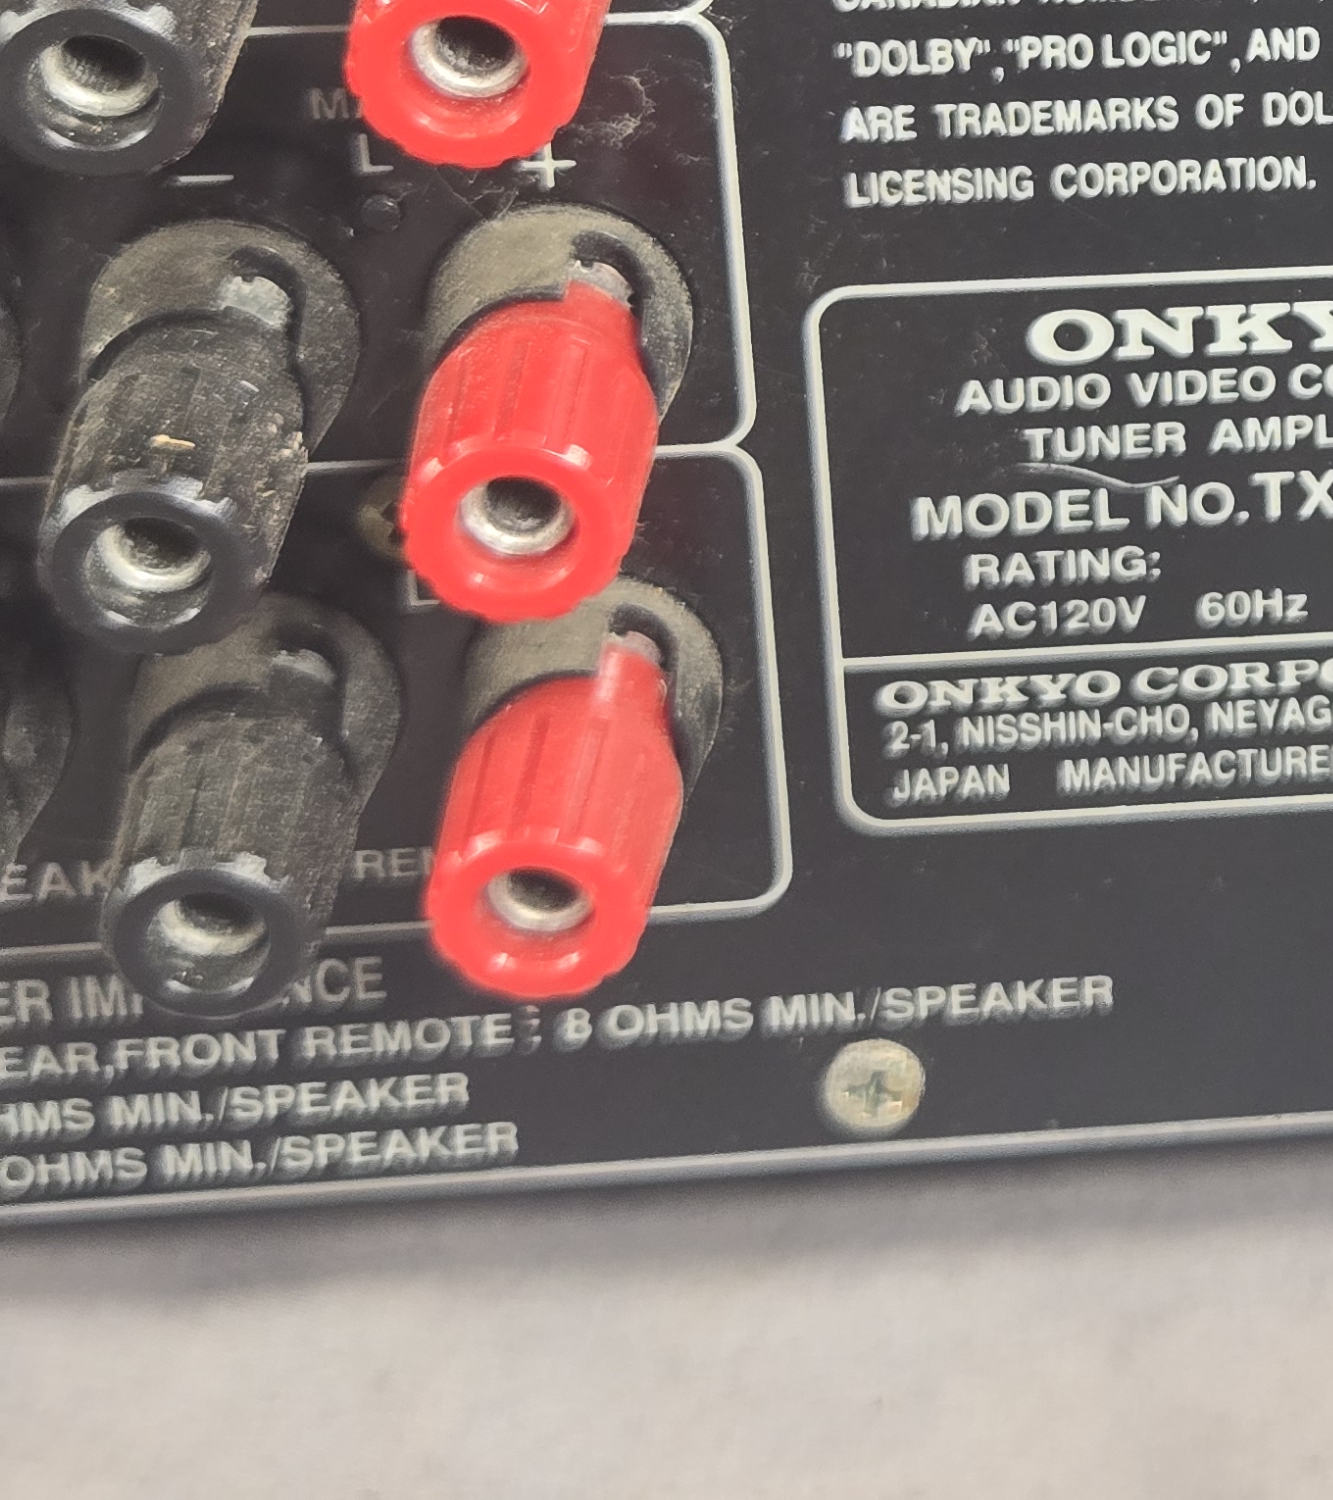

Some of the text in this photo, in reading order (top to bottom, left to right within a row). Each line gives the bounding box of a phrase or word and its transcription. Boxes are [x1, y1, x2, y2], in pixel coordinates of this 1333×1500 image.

[1246, 27, 1320, 62] AND
[841, 105, 917, 143] ARE
[934, 96, 1179, 137] TRADEMARKS
[1196, 94, 1244, 129] OF
[845, 156, 1316, 208] LICENSING CORPORATION.
[955, 373, 1111, 415] AUDIO
[1128, 366, 1276, 406] VIDEO
[1022, 422, 1186, 464] TUNER
[912, 489, 1131, 539] MODEL
[965, 546, 1161, 586] RATING:
[968, 595, 1146, 637] AC120V
[1197, 588, 1308, 626] 60Hz
[877, 670, 1121, 715] ONKYO
[956, 704, 1198, 749] NISSHIN-CHO,
[892, 764, 1010, 803] JAPAN
[564, 974, 1113, 1043] 8 OHMS MIN./SPEAKER
[107, 1072, 470, 1127] MIN./SPEAKER
[0, 1121, 519, 1187] OHMS MIN./SPEAKER
